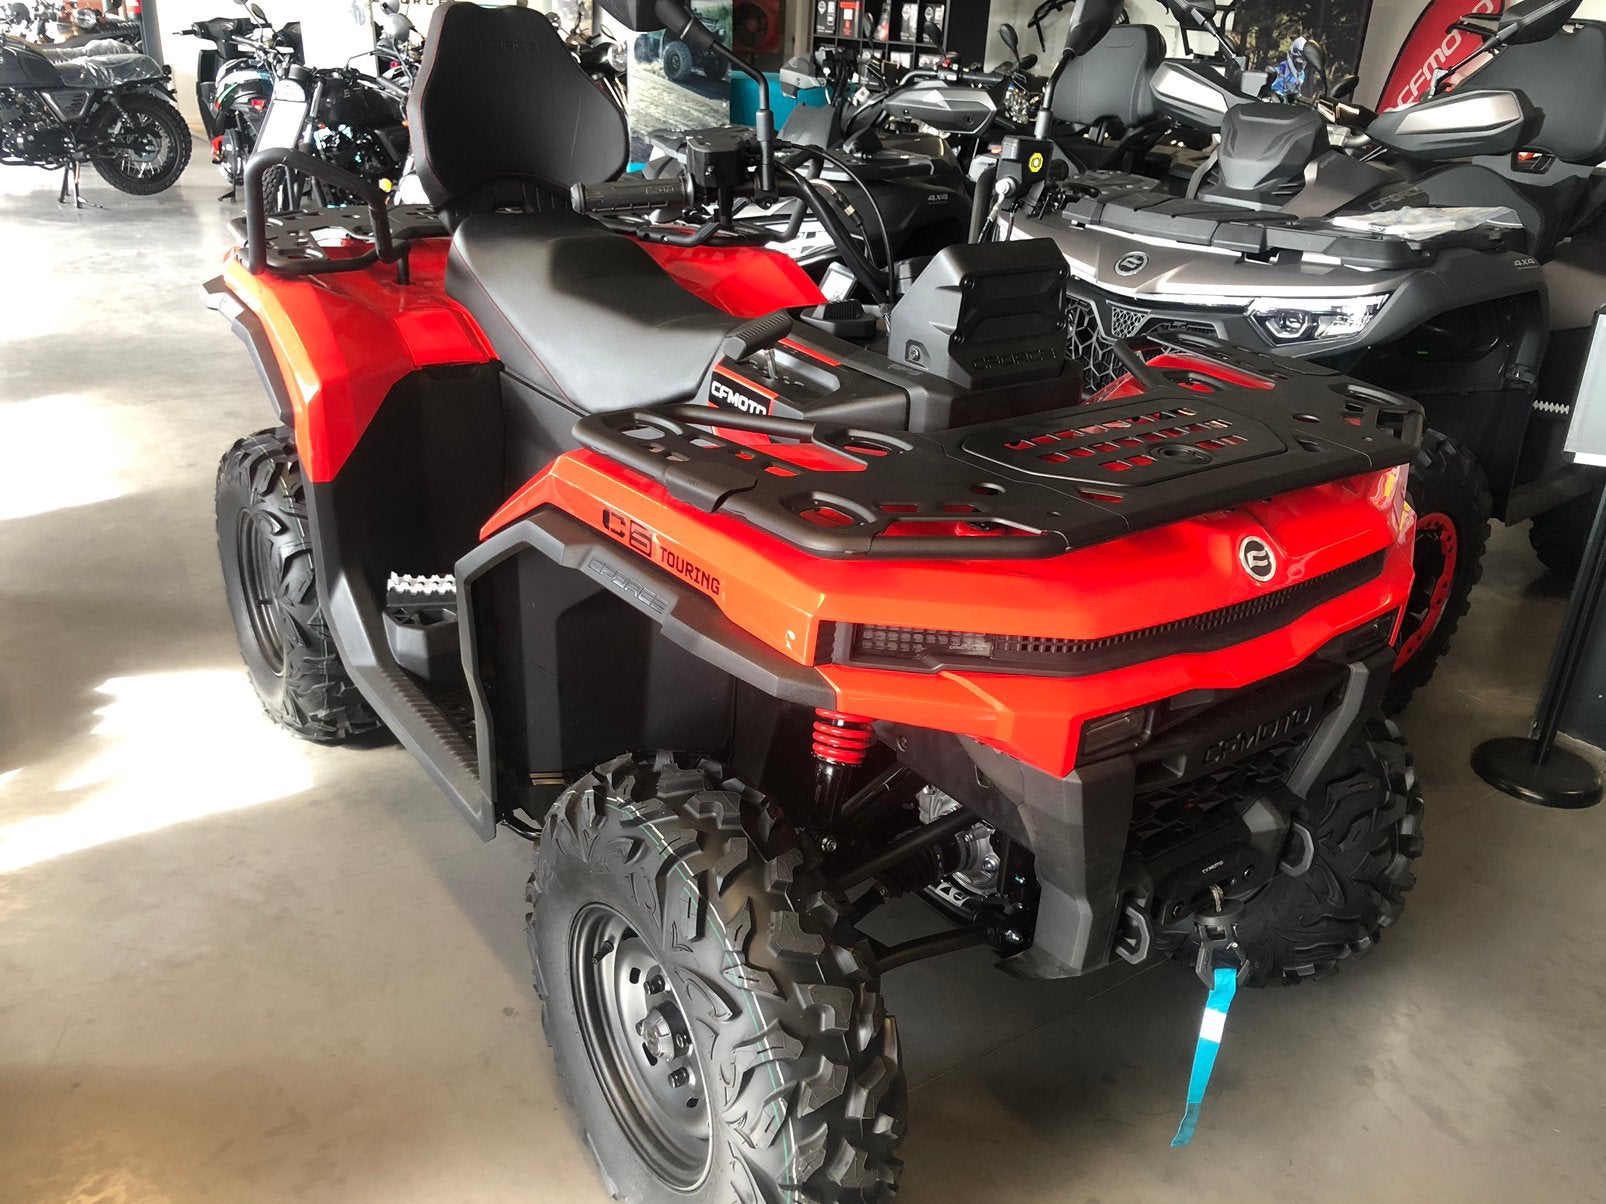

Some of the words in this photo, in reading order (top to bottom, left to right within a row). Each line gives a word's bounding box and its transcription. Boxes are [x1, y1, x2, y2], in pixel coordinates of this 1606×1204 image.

[1397, 0, 1494, 106] CFMOO
[711, 381, 767, 416] CFMOTO
[602, 507, 652, 558] C6
[660, 546, 720, 596] TOURING
[588, 557, 669, 615] CFORCE
[1202, 704, 1312, 767] CFMOTO
